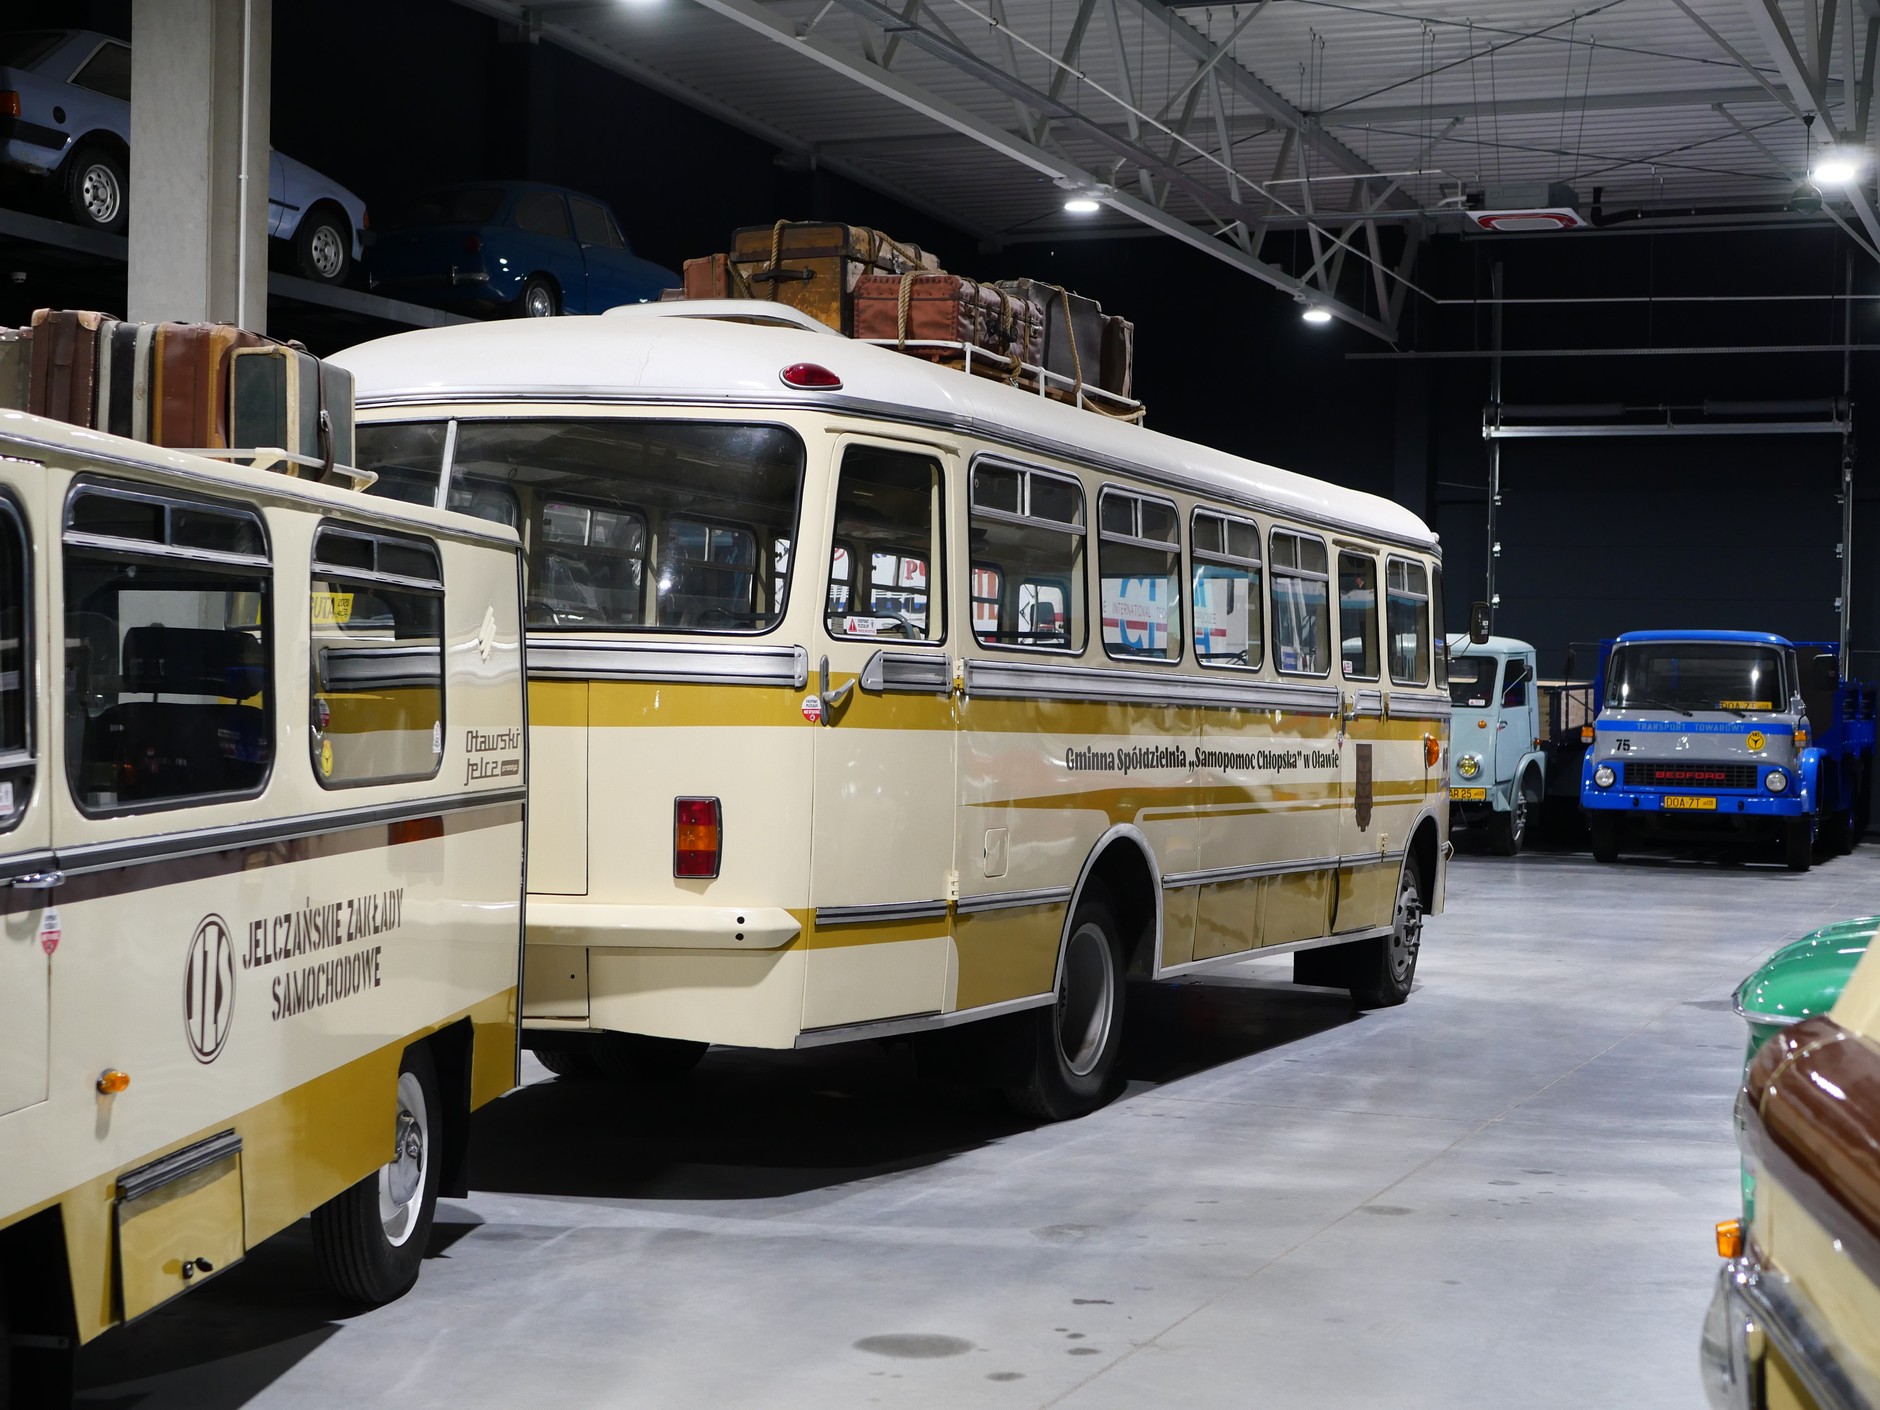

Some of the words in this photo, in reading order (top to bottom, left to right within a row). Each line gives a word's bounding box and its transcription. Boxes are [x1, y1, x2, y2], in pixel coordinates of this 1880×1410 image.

[1112, 602, 1151, 618] INTERNATIONAL
[1637, 722, 1686, 732] TRANSPORT
[1695, 723, 1745, 733] TOWAROWY
[1616, 739, 1631, 752] 75
[1065, 745, 1115, 771] Gminna
[1117, 745, 1187, 776] Spółdzielnia
[1303, 752, 1310, 769] w
[1311, 748, 1340, 769] Oławie
[1655, 771, 1725, 780] BEDFORD
[1461, 789, 1472, 799] 25
[1666, 797, 1686, 808] DOA
[1689, 797, 1701, 808] 7T
[242, 896, 343, 970] JELCZAŃSKIE
[346, 887, 404, 943] ZAKŁADY
[271, 945, 382, 1022] SAMOCHODOWE
